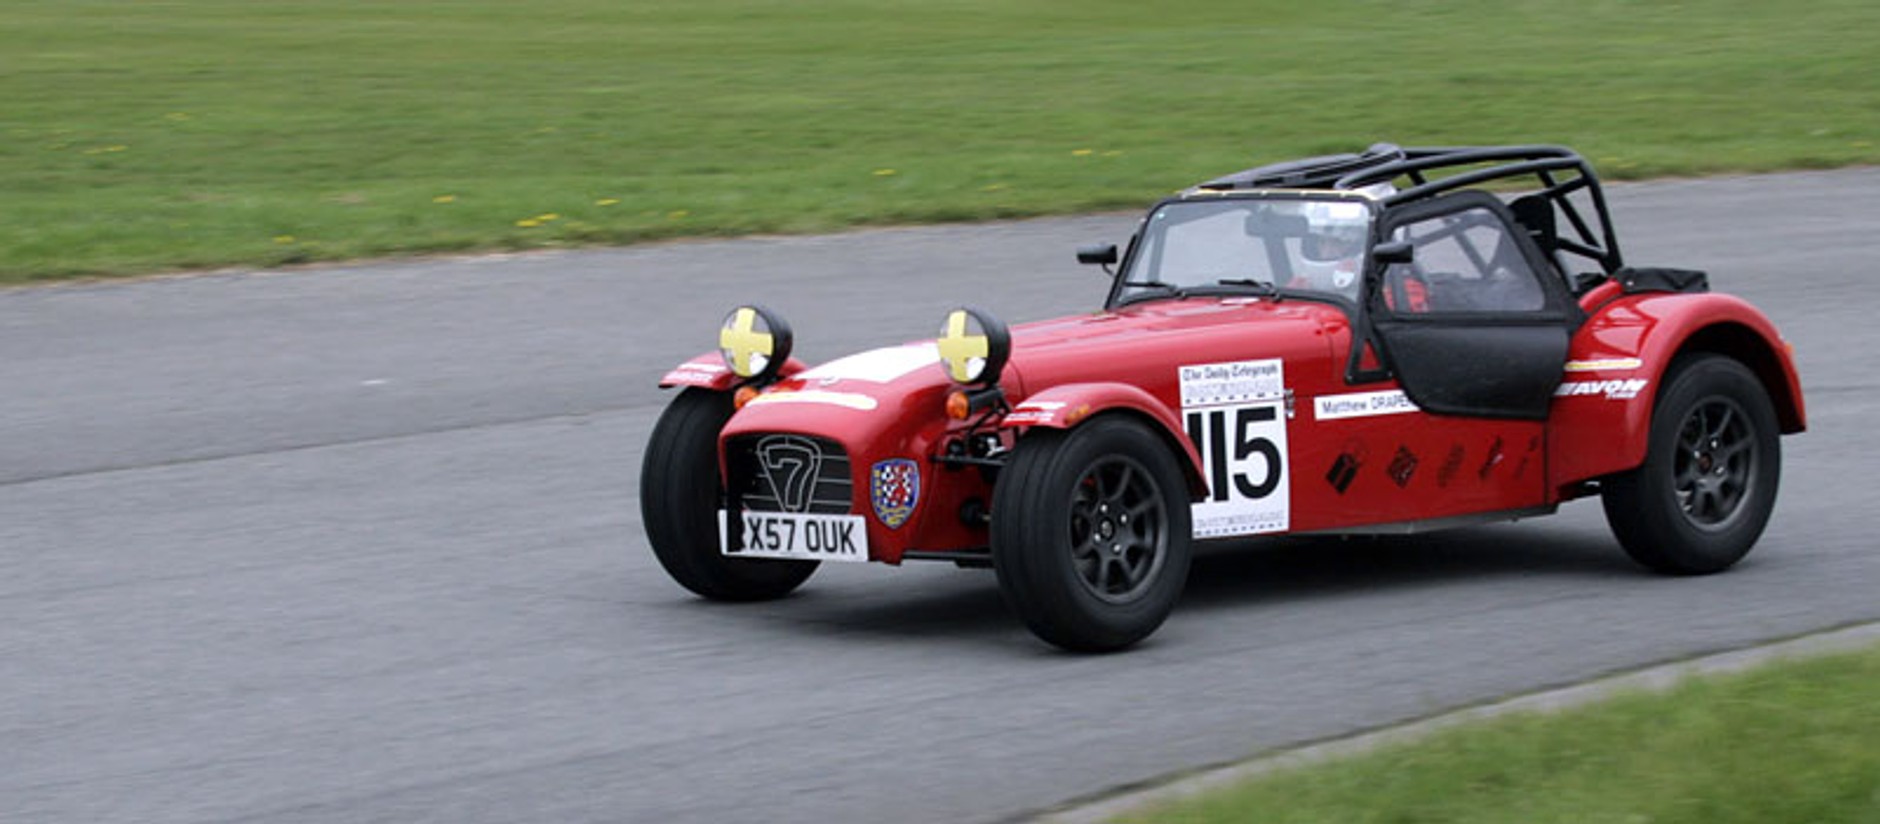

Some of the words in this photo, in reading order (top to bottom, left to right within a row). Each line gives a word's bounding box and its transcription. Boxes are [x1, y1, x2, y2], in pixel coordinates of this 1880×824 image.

[1573, 379, 1647, 395] AVON
[1323, 400, 1367, 414] Matthew
[765, 442, 815, 509] 7
[740, 516, 796, 551] X57
[804, 519, 857, 555] OUK
